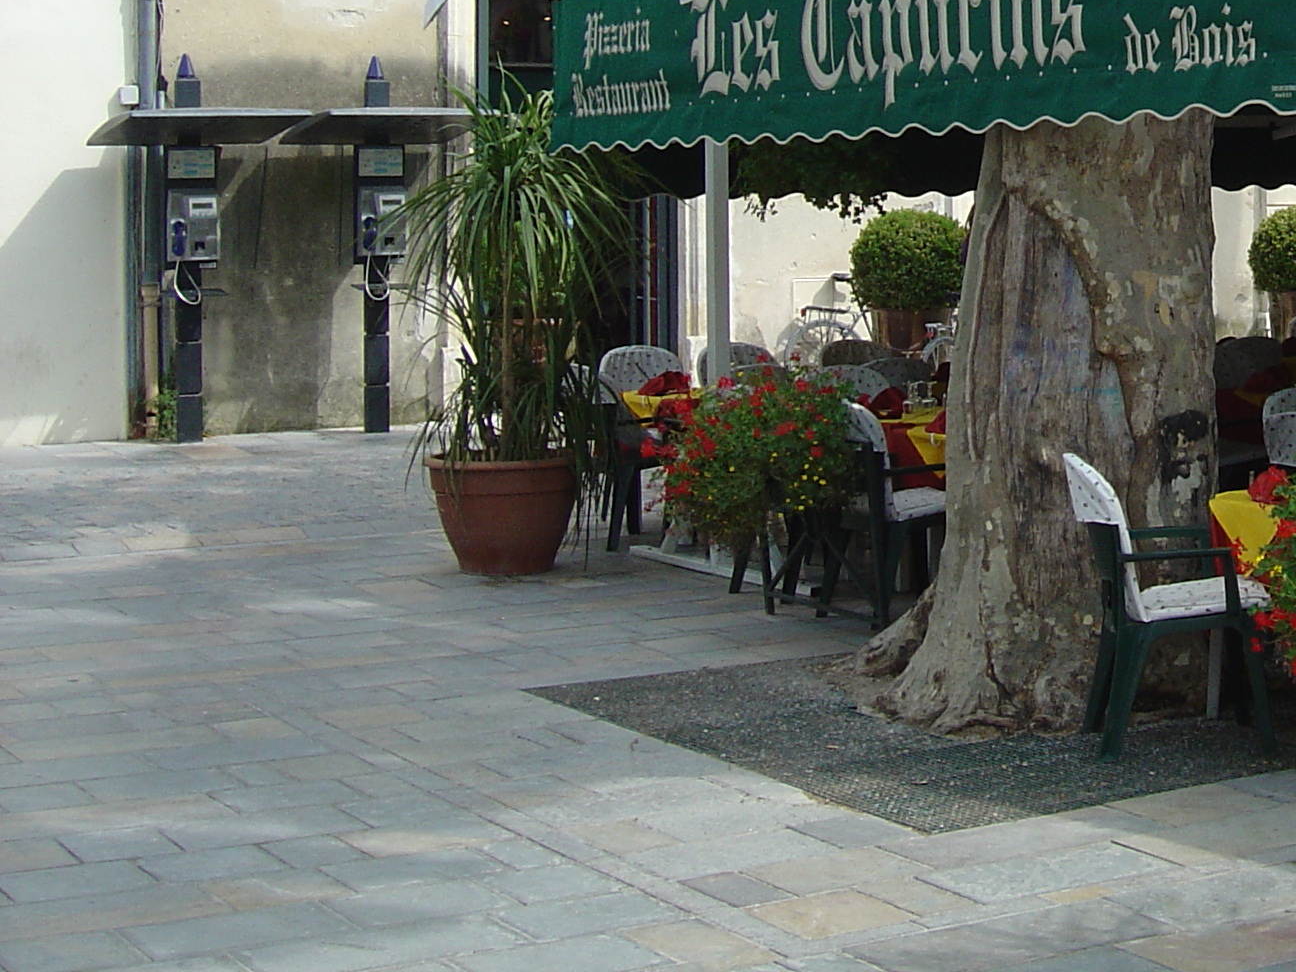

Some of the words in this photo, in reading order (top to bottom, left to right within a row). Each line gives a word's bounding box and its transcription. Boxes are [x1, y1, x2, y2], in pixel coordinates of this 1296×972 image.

[583, 6, 650, 70] Pizzeria
[1123, 13, 1161, 75] de
[1169, 2, 1256, 72] Bois
[572, 68, 671, 118] Restaurant
